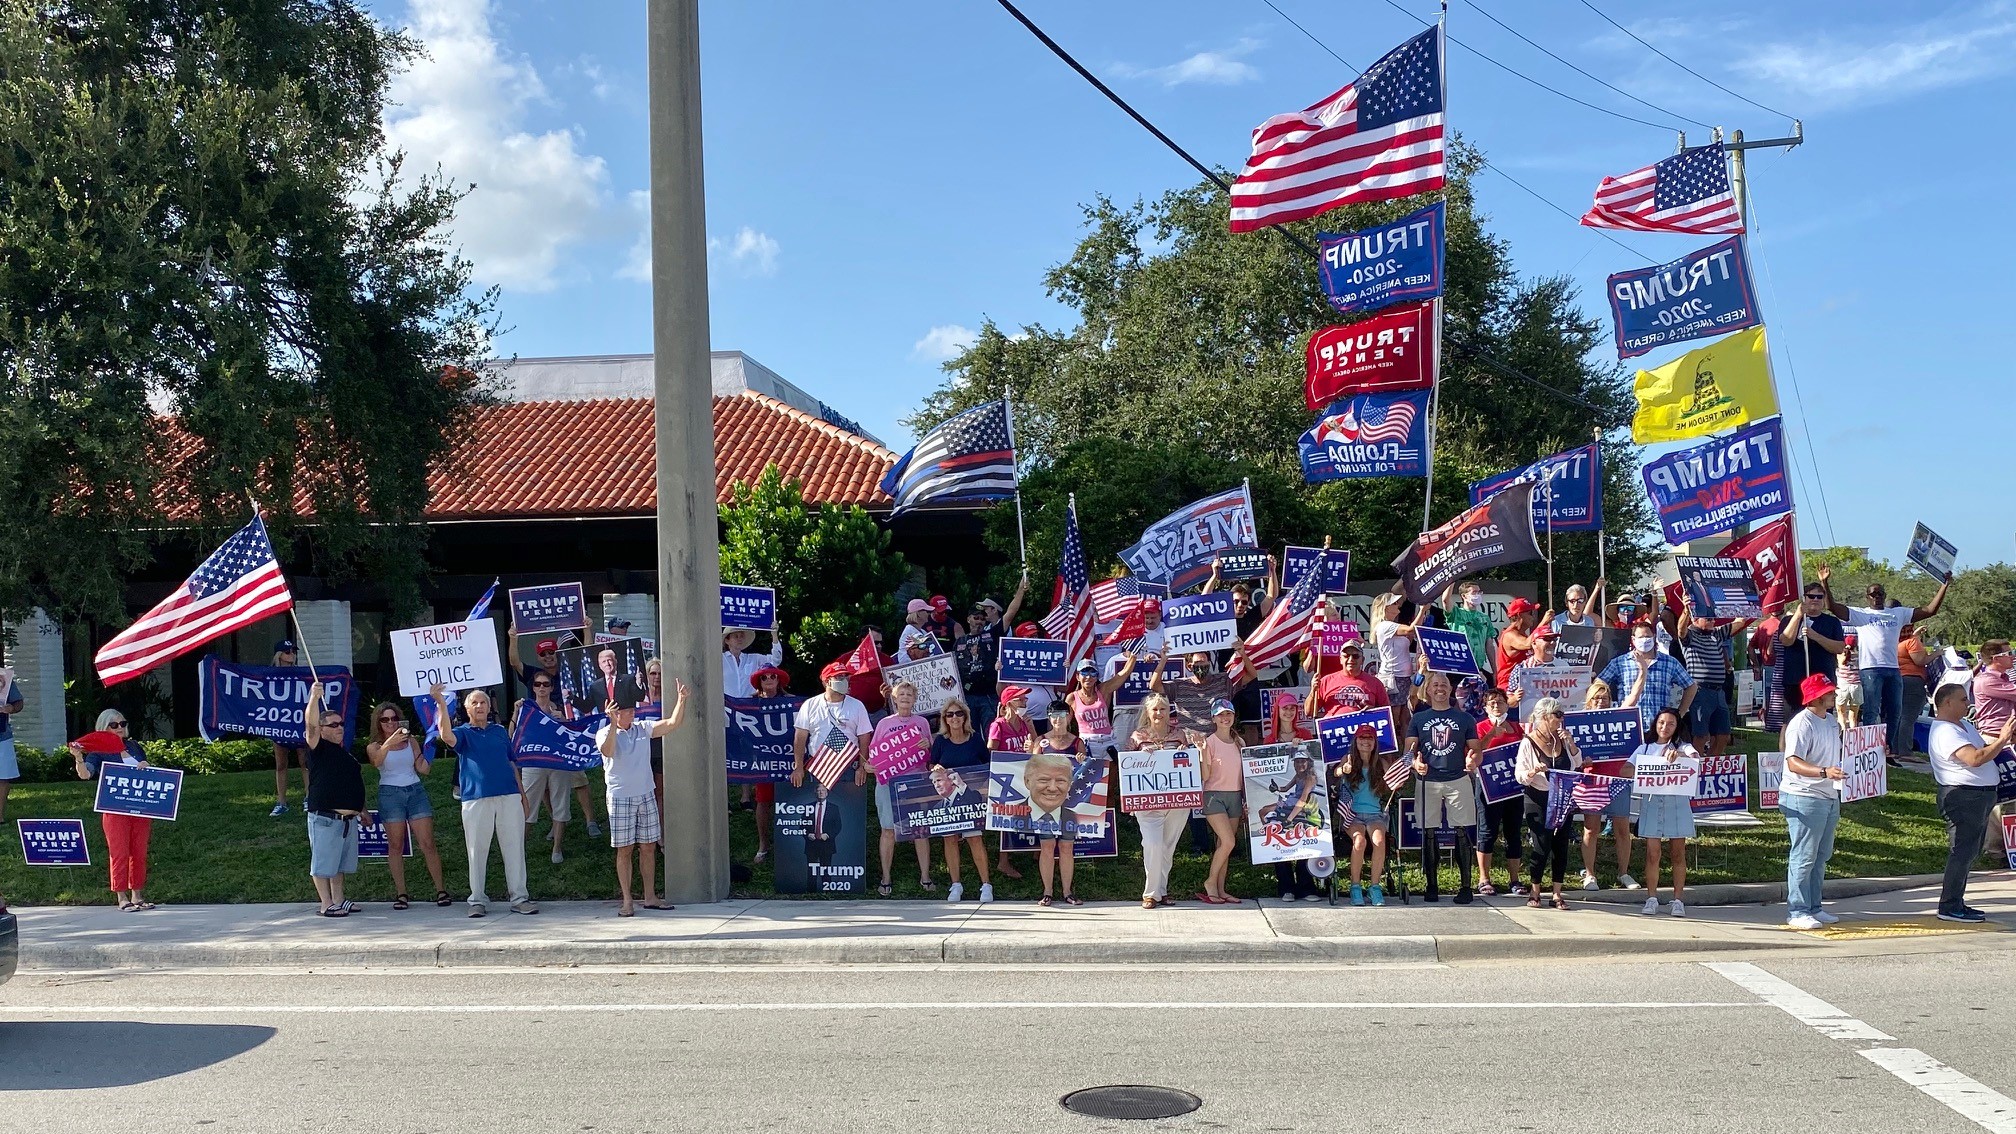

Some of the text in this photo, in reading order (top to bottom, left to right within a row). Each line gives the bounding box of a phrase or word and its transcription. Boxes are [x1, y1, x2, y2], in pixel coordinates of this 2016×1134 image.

[1220, 555, 1268, 563] TRUMP
[1224, 561, 1263, 569] PENCE
[1677, 556, 1699, 568] VOTE
[1700, 557, 1732, 568] PROLIFE
[1292, 568, 1338, 577] PEE
[1700, 569, 1718, 579] VOTE
[1719, 569, 1745, 579] TRUMP
[515, 595, 579, 611] TRUMP
[720, 596, 771, 608] RUMP
[523, 606, 574, 617] PENCE
[1169, 599, 1228, 620] טראמפ
[1323, 624, 1358, 633] OMEN
[410, 625, 468, 646] TRUMP
[1171, 628, 1231, 648] TRUMP
[1422, 638, 1468, 651] TRUMP
[1558, 642, 1590, 656] Keep
[419, 646, 464, 660] SUPPORTS
[1003, 649, 1064, 661] TRUMP
[1430, 649, 1468, 659] PENCE
[1008, 660, 1058, 668] PENCE
[416, 665, 475, 688] POLICE
[219, 668, 343, 705] TRUMP
[1532, 678, 1578, 689] THANK
[248, 706, 304, 724] -2020
[218, 722, 300, 739] KEEP AMERICA
[1565, 721, 1637, 736] TRUMP
[869, 725, 920, 758] WOMEN
[1573, 733, 1632, 743] PENCE
[519, 744, 550, 754] KEEP
[888, 747, 908, 761] FOR
[879, 750, 926, 780] TRUMP
[1121, 753, 1157, 774] Cindy
[1249, 758, 1276, 768] BELIEVE
[1637, 763, 1681, 771] STUDENTS
[1715, 759, 1740, 771] FOR
[1855, 750, 1879, 775] ENDED
[1250, 766, 1285, 774] YOURSELF
[105, 775, 175, 792] TRUMP
[1124, 771, 1200, 792] TINDELL
[1637, 775, 1690, 787] TRUMP
[1699, 774, 1744, 799] AST
[1845, 765, 1884, 800] SLAVERY
[109, 787, 168, 800] PENCE
[1125, 793, 1200, 806] REPUBLICAN
[1707, 798, 1736, 806] CONGRESS
[775, 802, 815, 816] Keep
[908, 802, 986, 820] WE ARE WITH YO
[991, 803, 1032, 817] TRUMP
[776, 818, 813, 827] America
[909, 814, 961, 828] PRESIDENT
[991, 816, 1099, 834] Make Israel Great
[23, 831, 81, 841] TRUMP
[782, 827, 807, 836] Great
[1259, 822, 1320, 847] Reba
[1302, 838, 1319, 846] 2020
[808, 862, 865, 879] Trump
[822, 881, 851, 891] 2020
